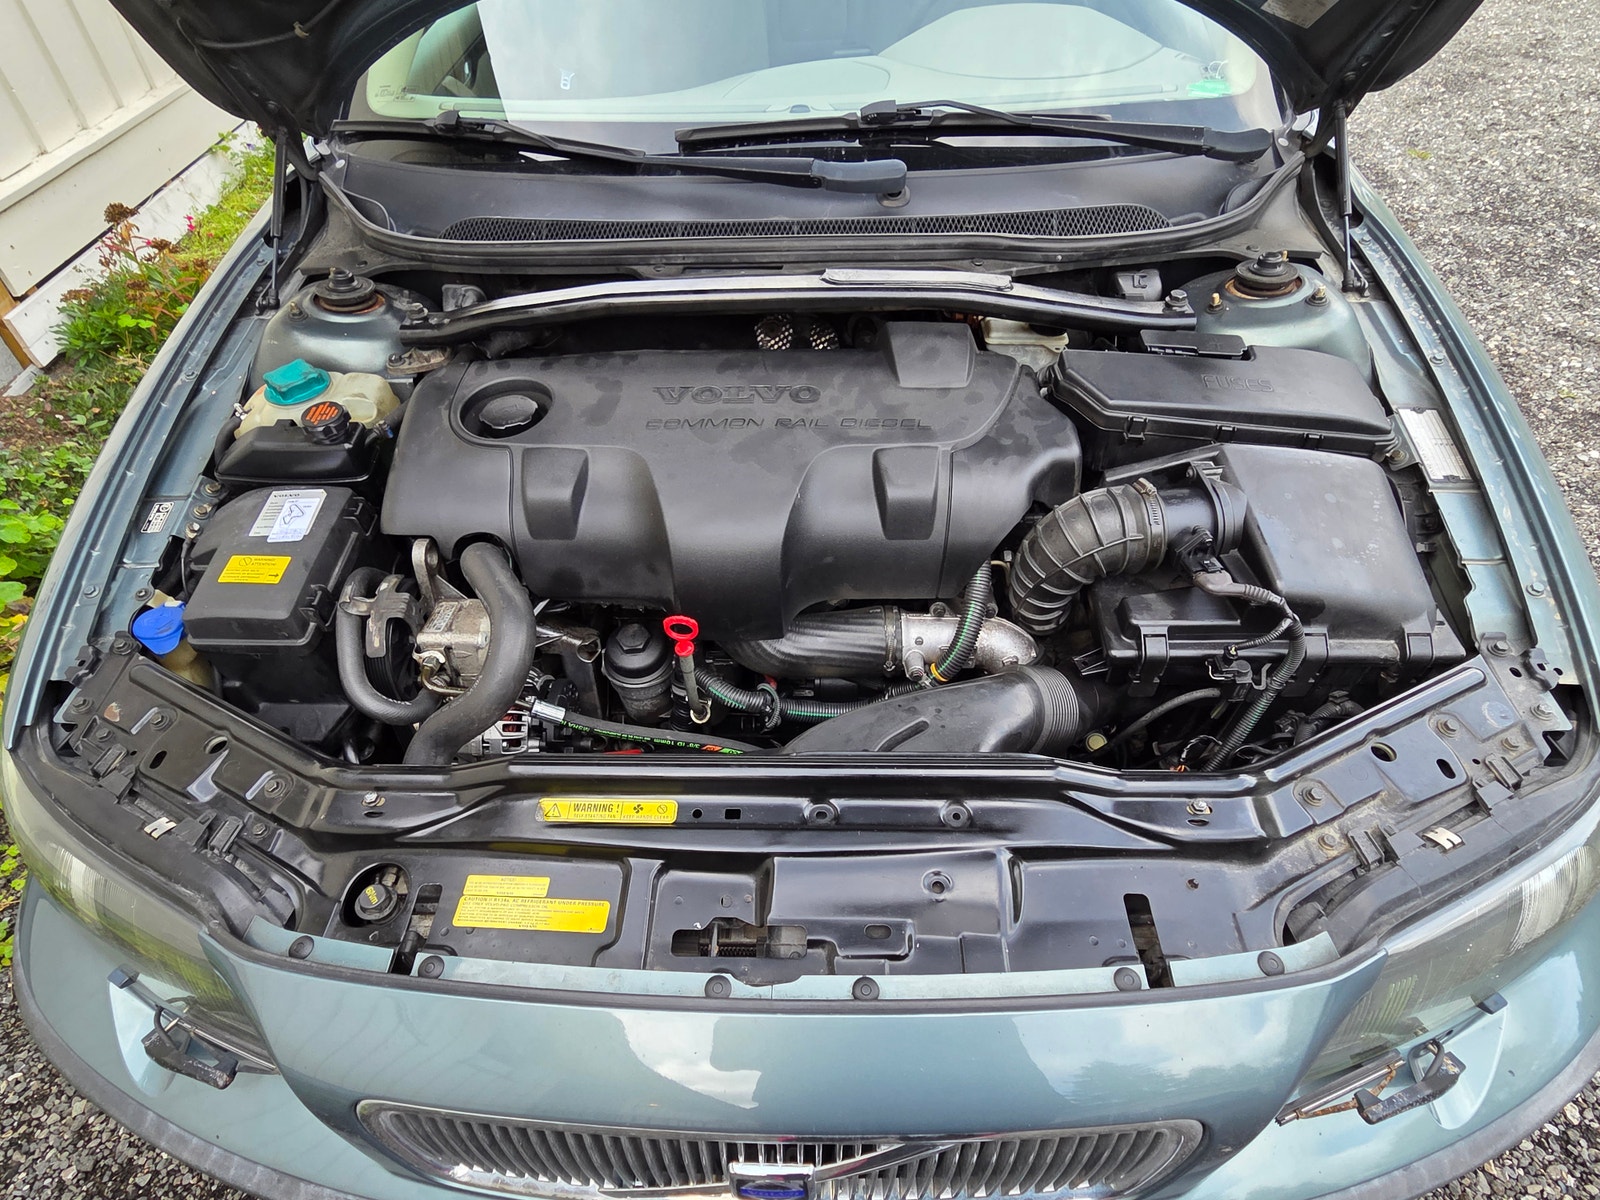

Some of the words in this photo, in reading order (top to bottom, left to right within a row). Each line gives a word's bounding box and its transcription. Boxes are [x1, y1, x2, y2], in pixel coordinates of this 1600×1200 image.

[1201, 374, 1274, 392] FUSES
[652, 385, 821, 404] VOLVO
[646, 417, 764, 430] COMMON
[774, 417, 829, 430] RAIL
[840, 417, 932, 430] DIESEL
[573, 803, 613, 812] WARNING
